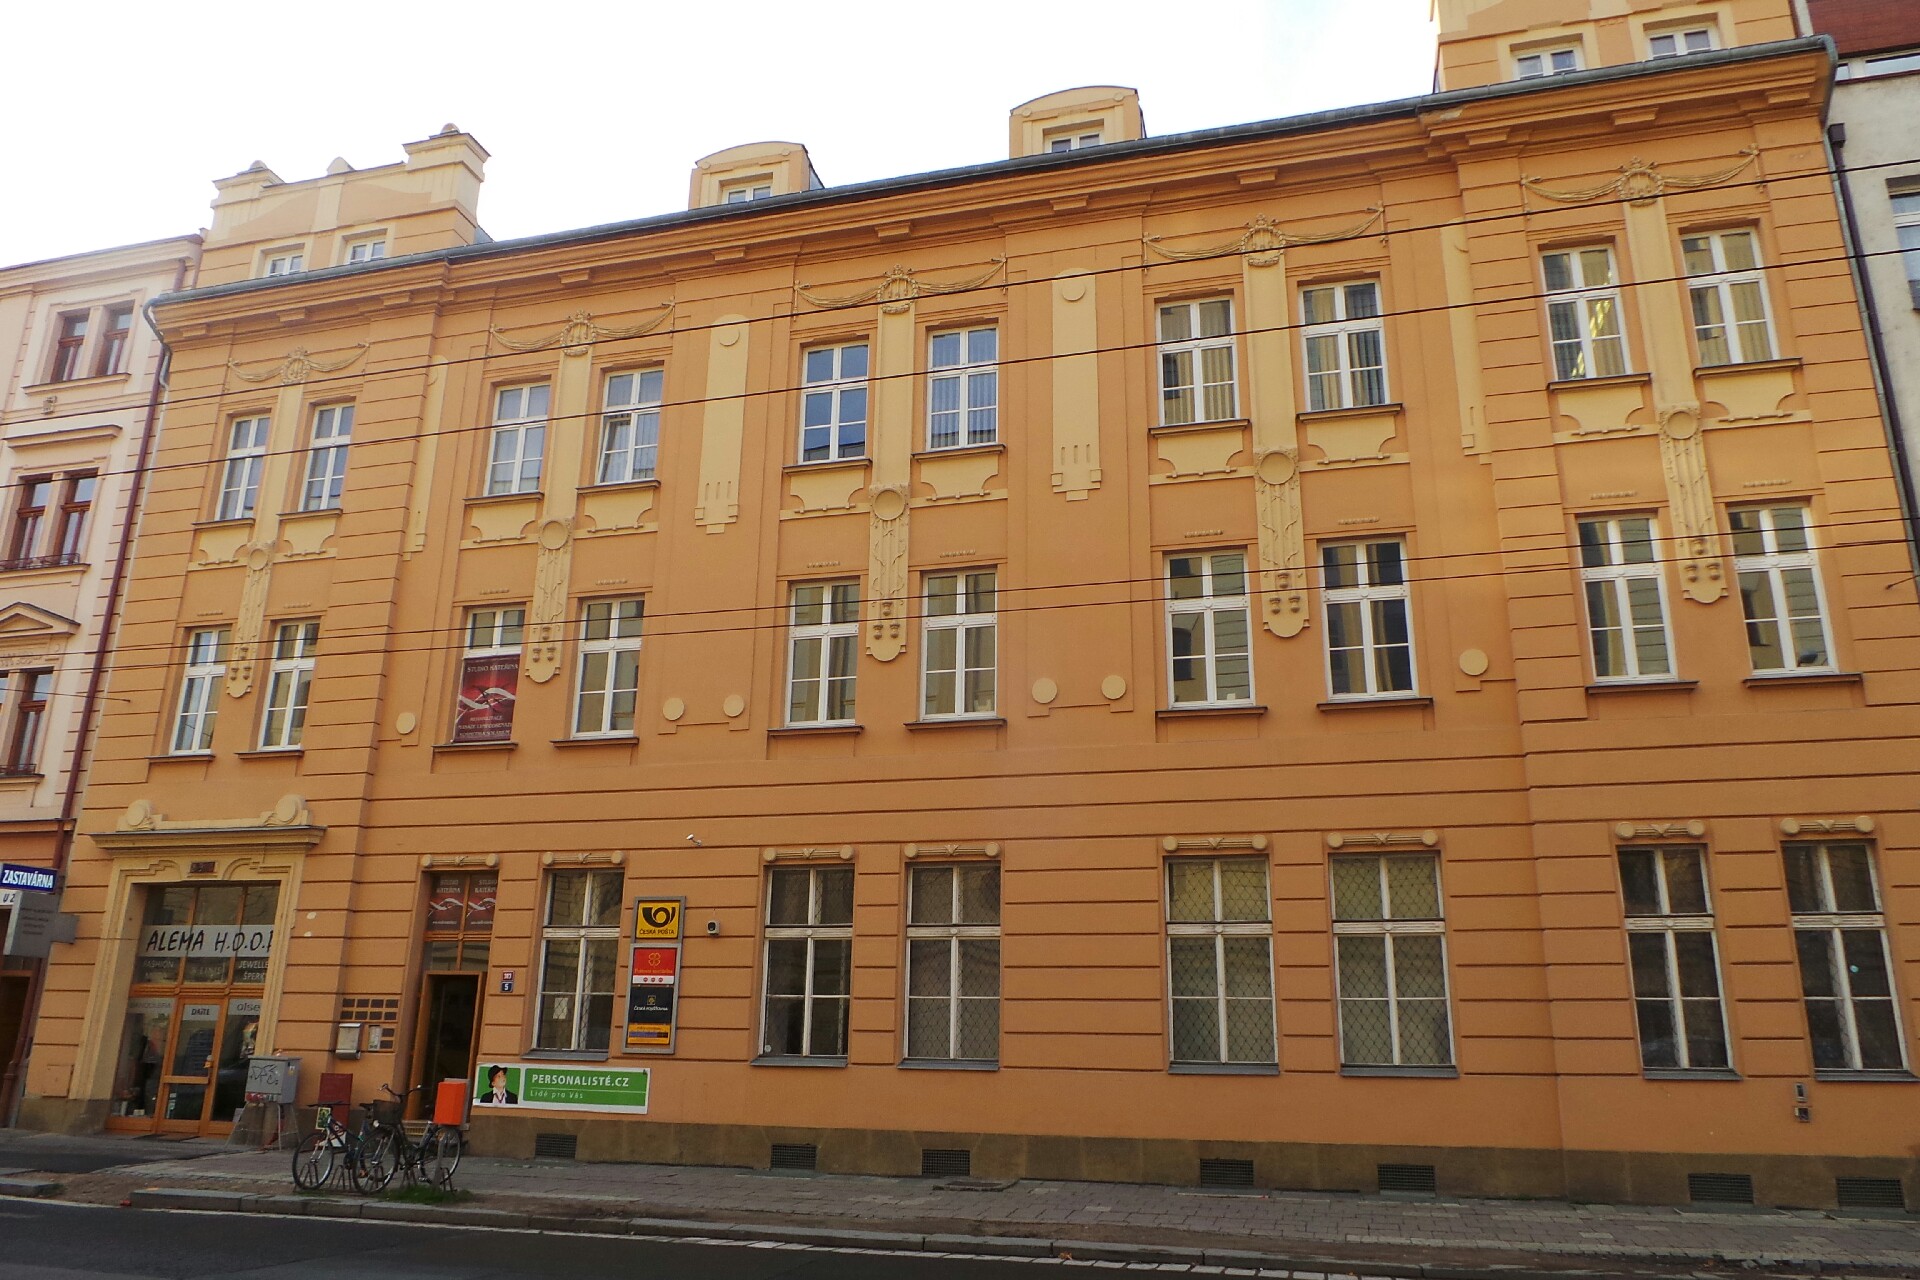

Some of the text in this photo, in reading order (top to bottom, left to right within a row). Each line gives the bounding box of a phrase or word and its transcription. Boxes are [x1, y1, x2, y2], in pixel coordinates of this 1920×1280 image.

[2, 869, 54, 888] ZASTAVÁRNA
[146, 930, 204, 952] ALEMA
[504, 983, 509, 991] 5
[531, 1074, 629, 1086] PERSONALISTÉ.CZ
[530, 1089, 584, 1099] Lidé pro Vás
